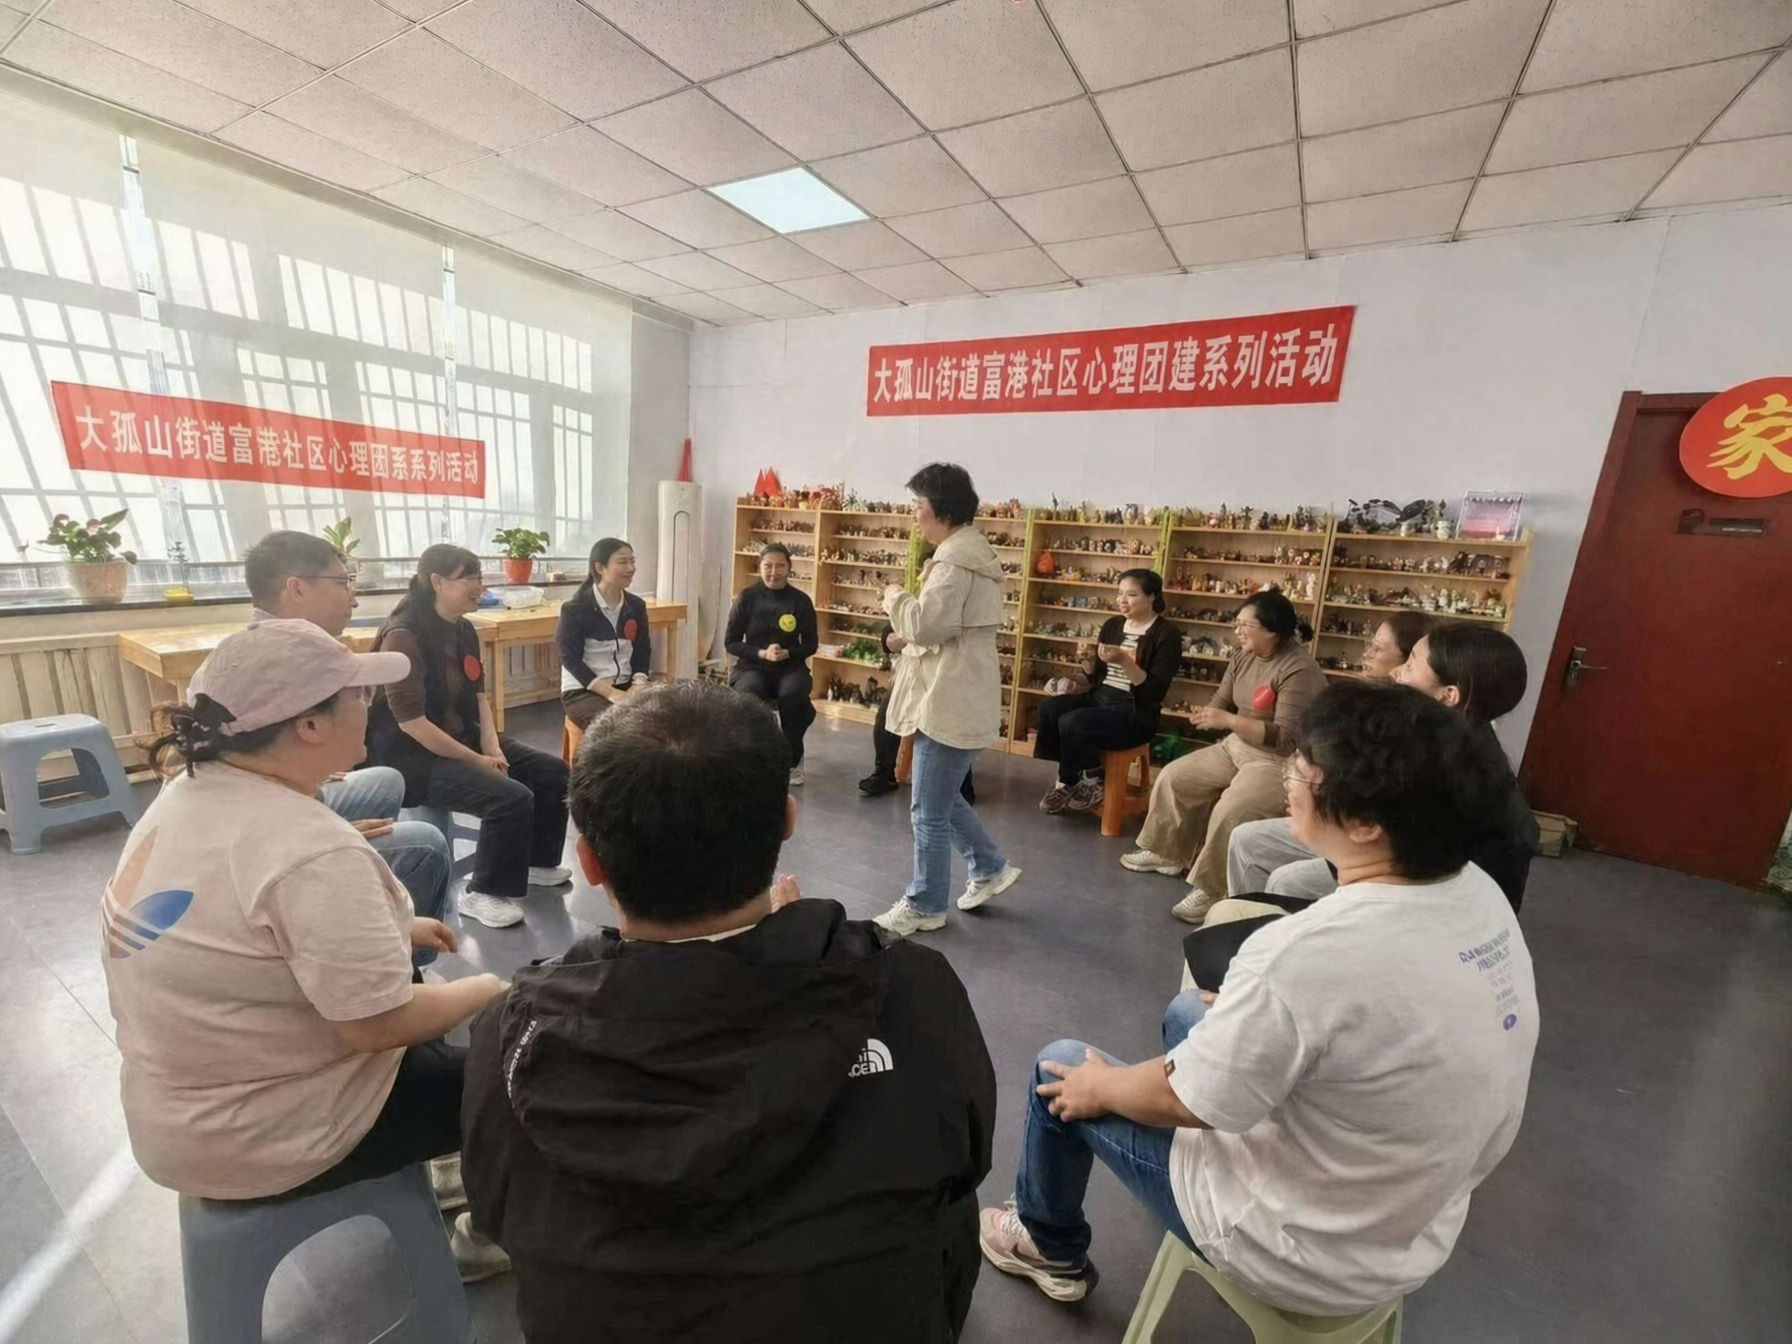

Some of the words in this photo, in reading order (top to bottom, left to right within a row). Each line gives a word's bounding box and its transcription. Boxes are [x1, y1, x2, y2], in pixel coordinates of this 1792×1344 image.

[873, 323, 1338, 403] 大孤山街道富港社区心理团建系列活动
[1706, 393, 1792, 480] 家
